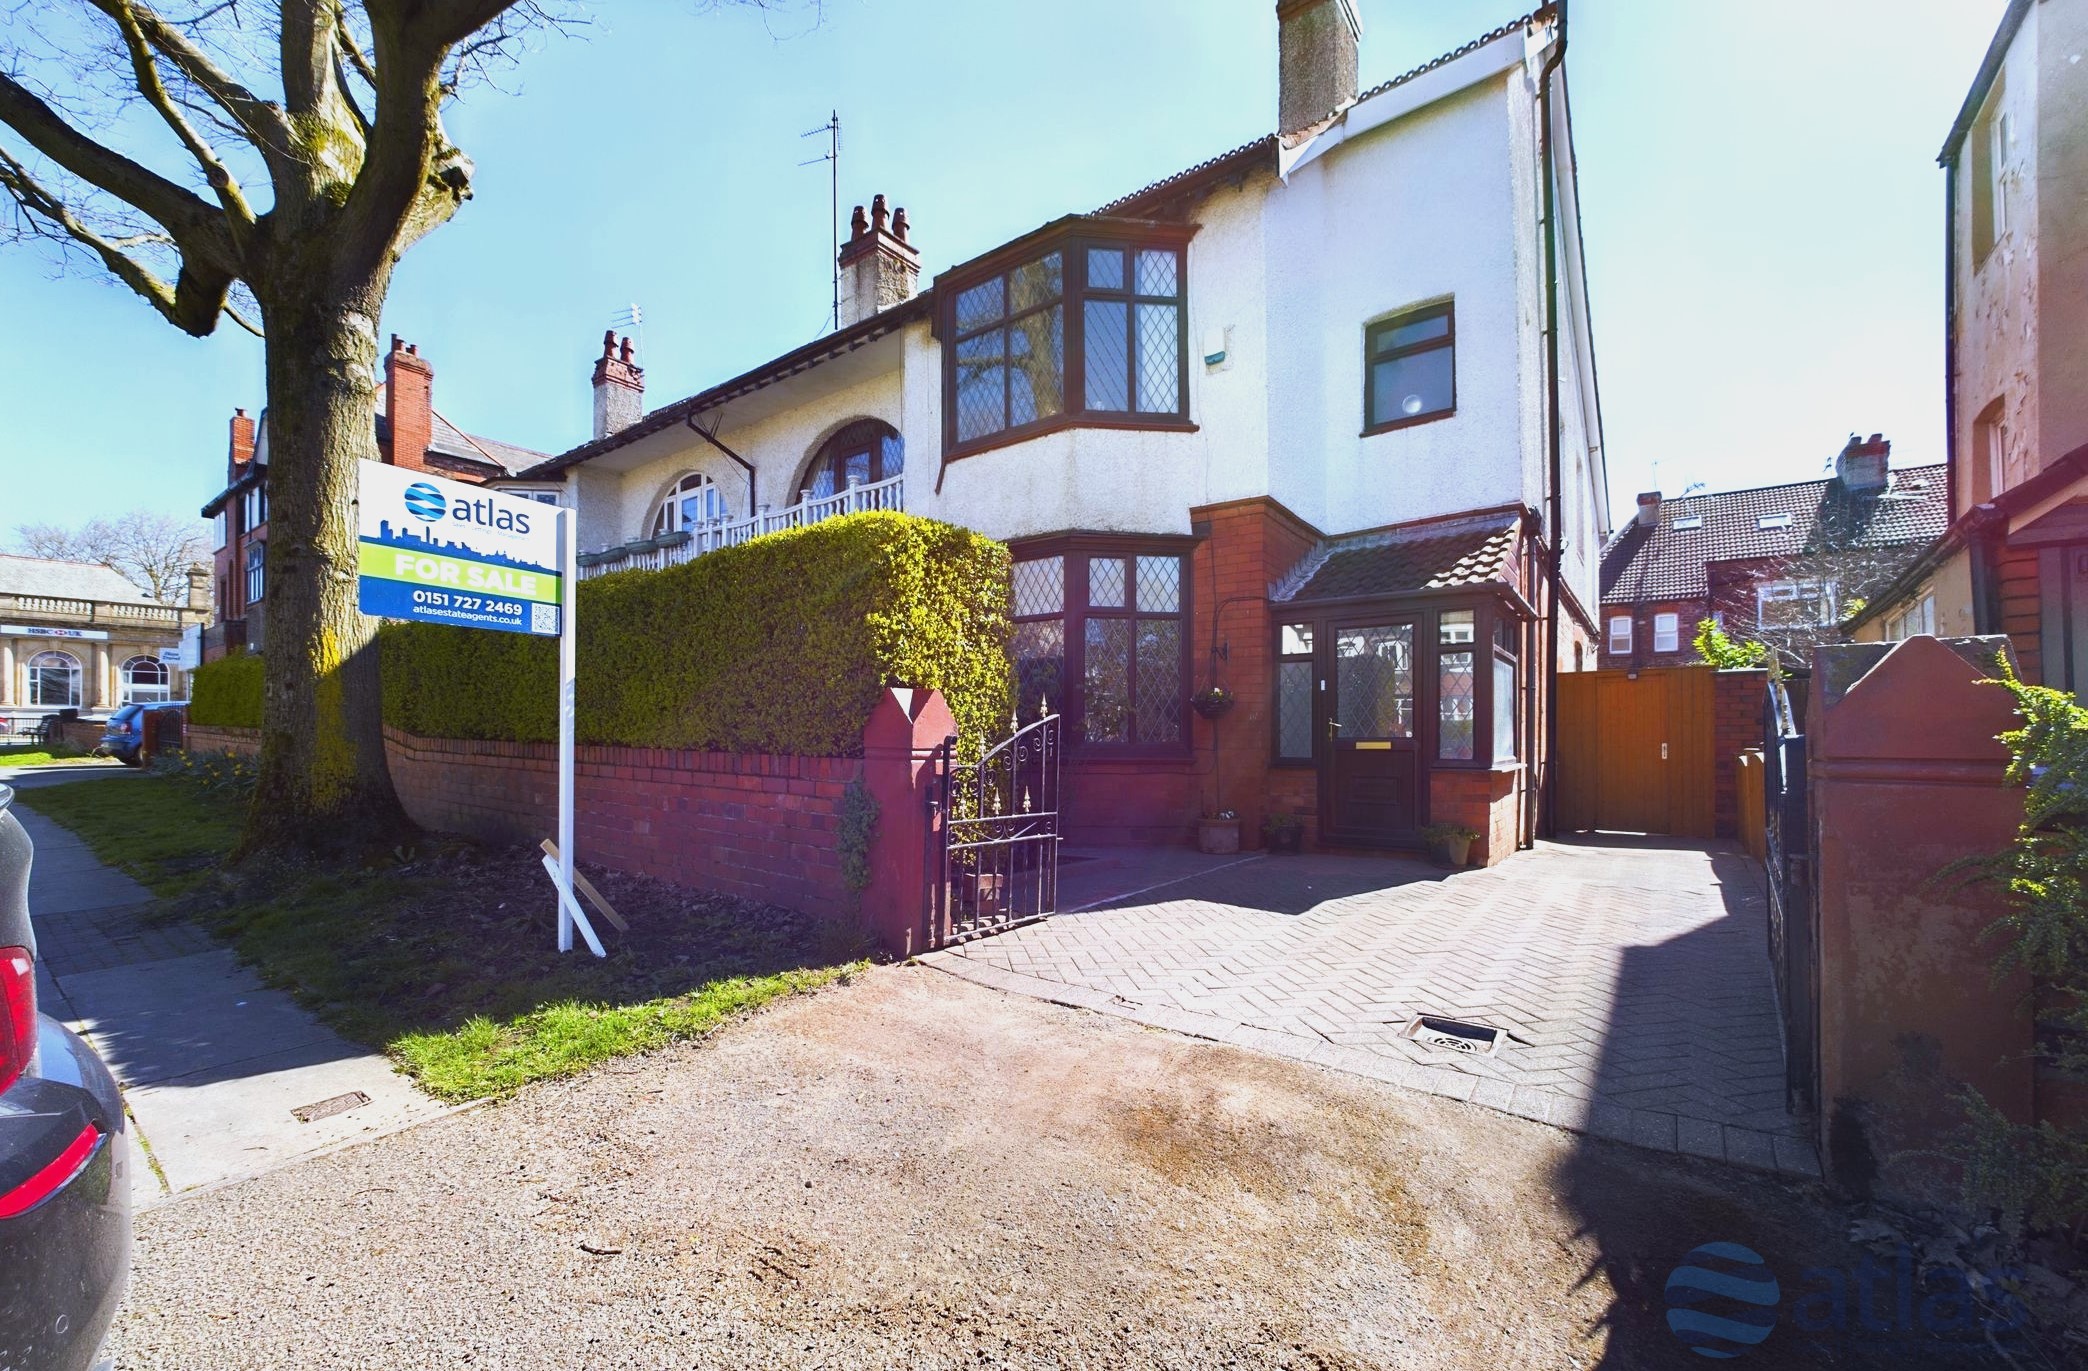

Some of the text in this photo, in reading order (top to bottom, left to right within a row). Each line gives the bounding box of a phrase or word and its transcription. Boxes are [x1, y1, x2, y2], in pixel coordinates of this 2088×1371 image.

[452, 498, 530, 534] atlas
[395, 554, 537, 596] FOR SALE
[413, 590, 523, 616] 0151 727 2469
[413, 605, 523, 626] atlasestateagents.co.uk
